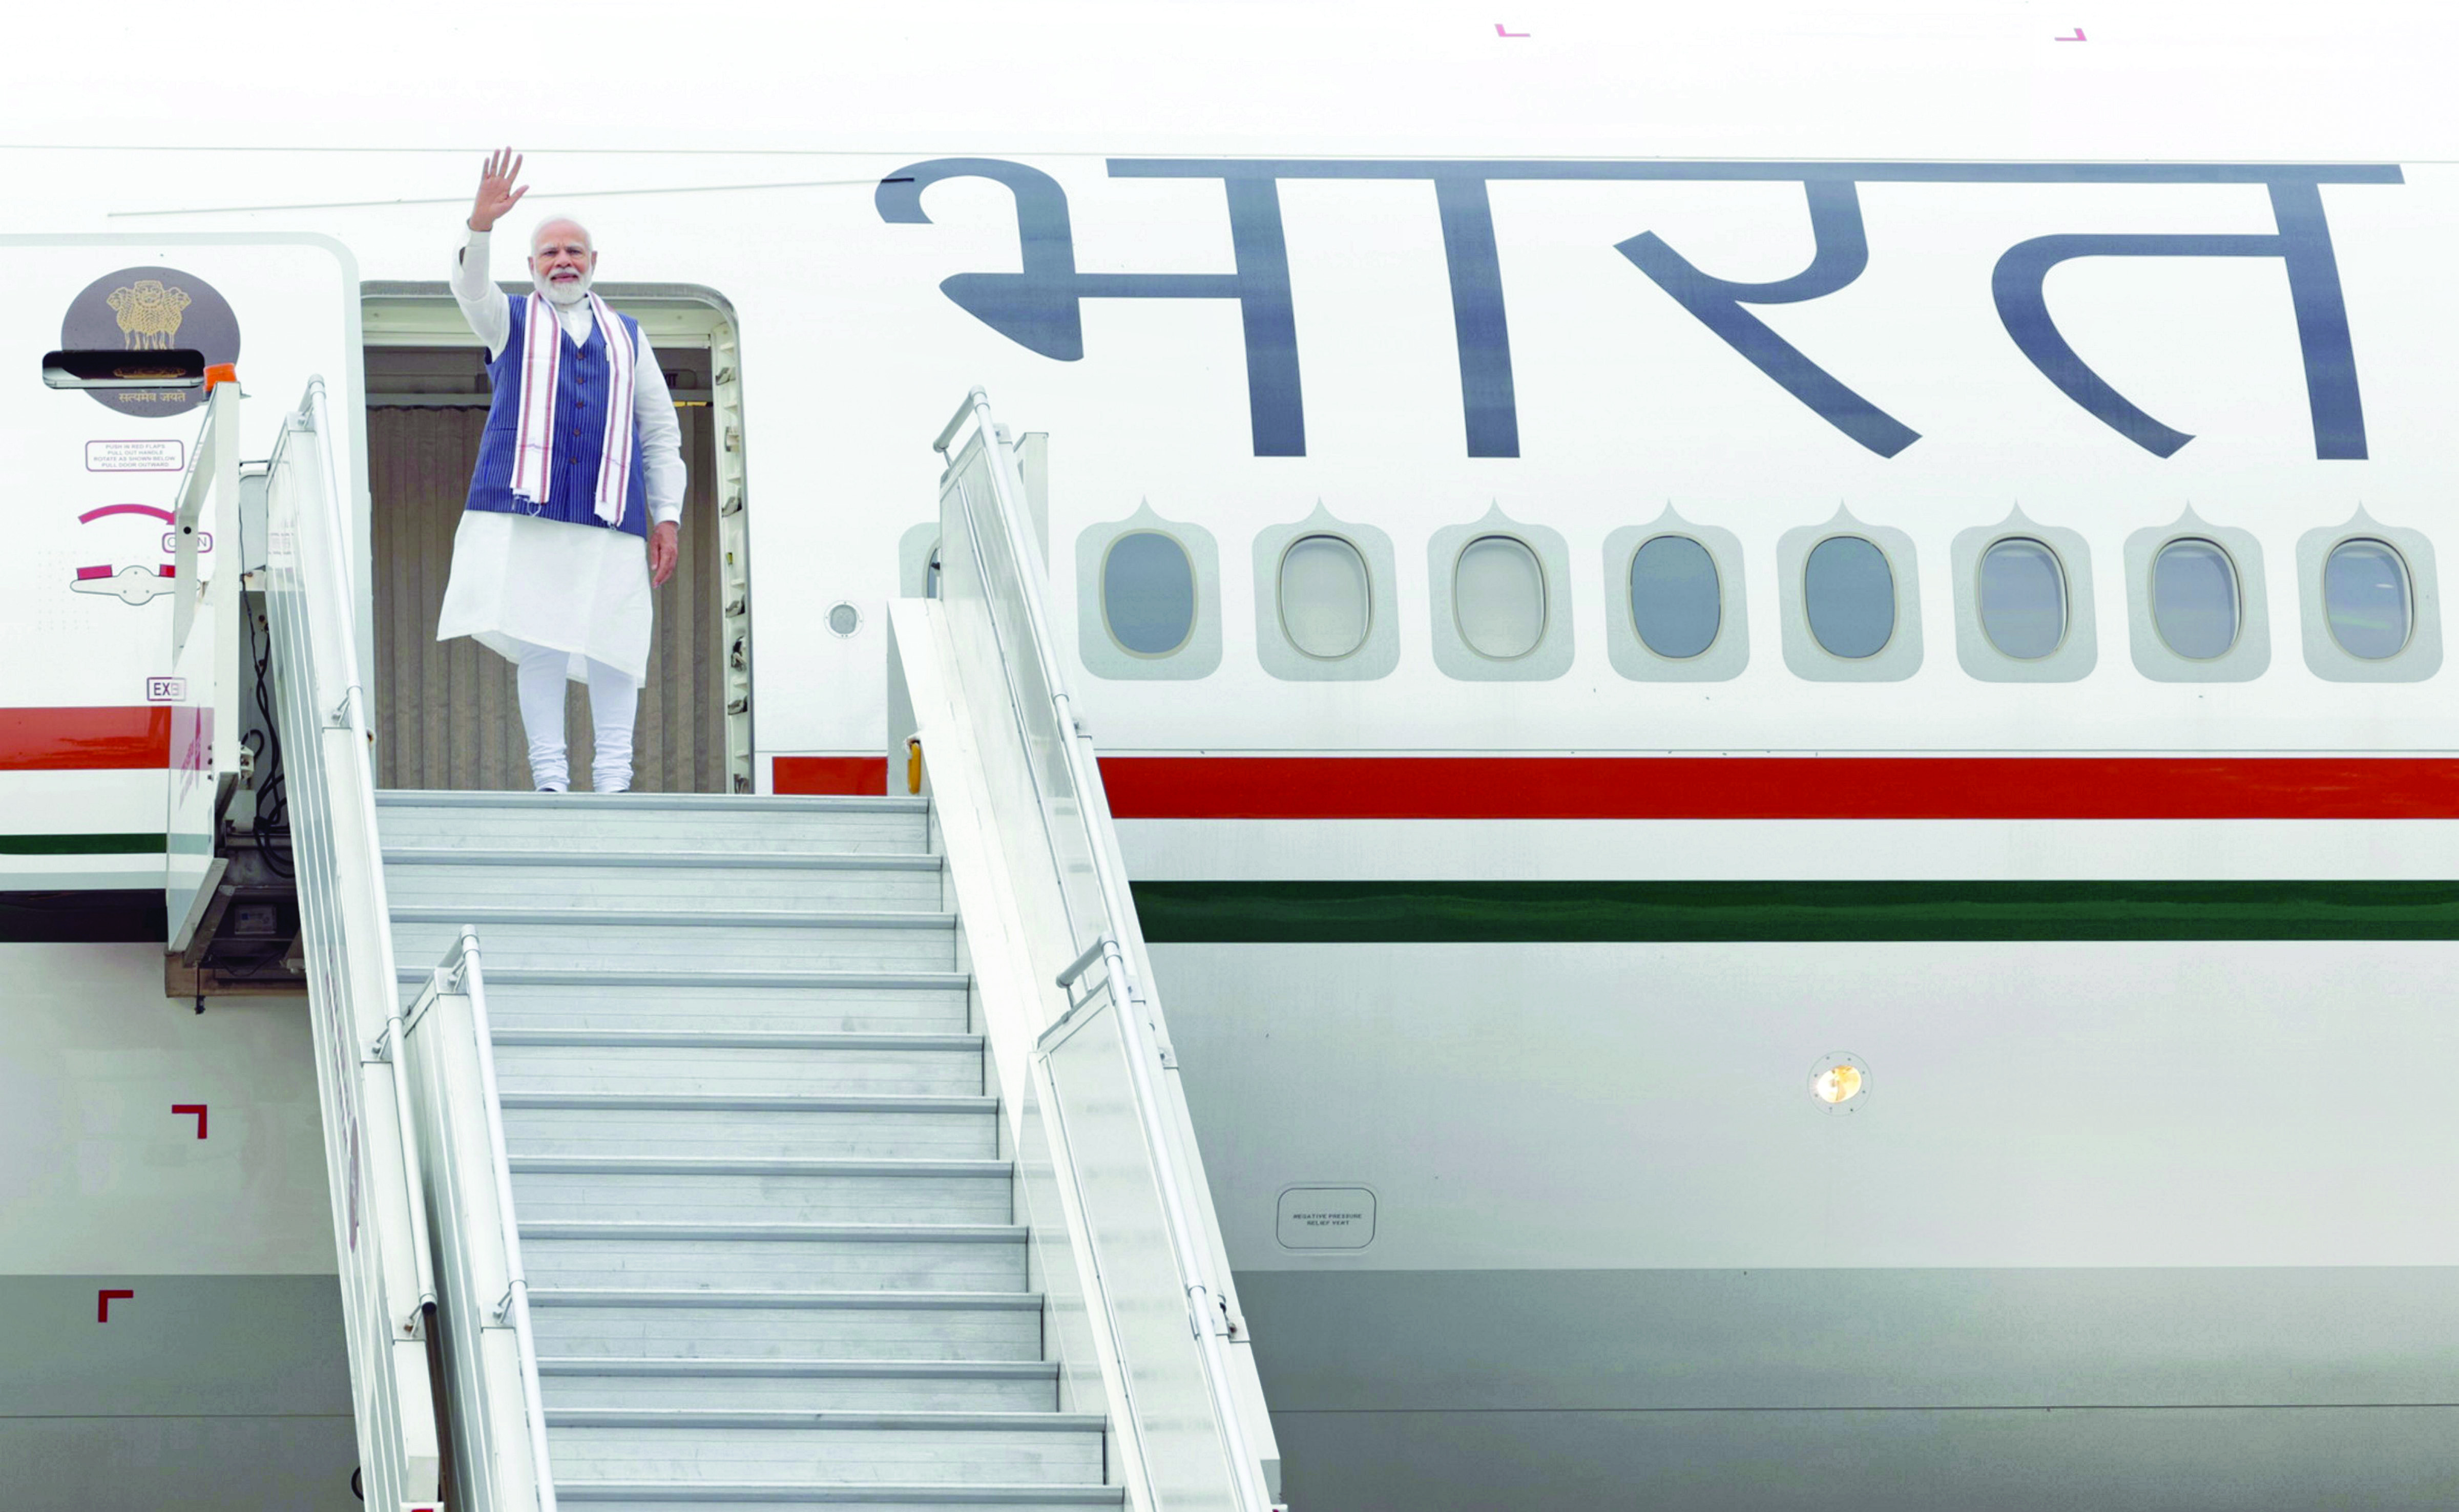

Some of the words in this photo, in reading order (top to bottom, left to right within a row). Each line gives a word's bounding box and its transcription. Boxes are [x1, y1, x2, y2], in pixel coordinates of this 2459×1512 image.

[875, 157, 2404, 460] भारत
[118, 389, 157, 403] सत्यमेव
[159, 389, 186, 403] जयते
[167, 537, 206, 548] ON
